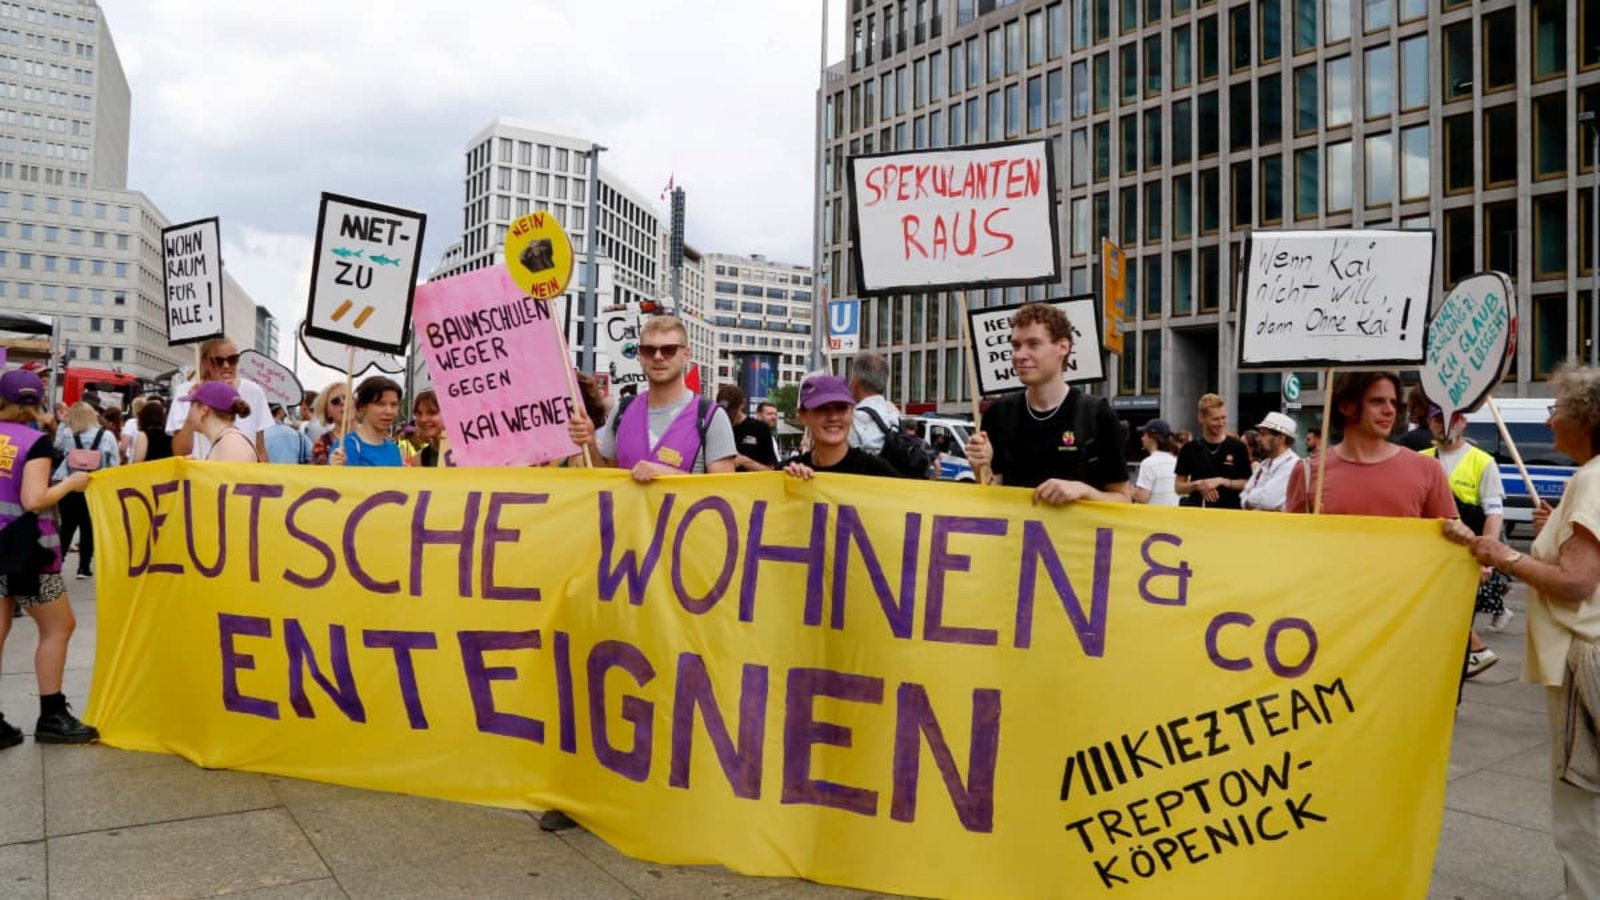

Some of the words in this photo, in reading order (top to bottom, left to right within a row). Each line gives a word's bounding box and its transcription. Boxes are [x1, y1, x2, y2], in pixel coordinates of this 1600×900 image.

[864, 157, 1041, 206] SPEKULANTEN
[166, 230, 203, 258] WOHN
[513, 212, 545, 238] NEIN
[901, 207, 1015, 261] RAUS
[168, 254, 207, 279] RAUM
[334, 260, 373, 289] ZU
[1259, 238, 1313, 275] Wenn
[1329, 237, 1376, 280] Kai
[531, 277, 560, 297] NEIN
[1256, 274, 1320, 303] nicht
[426, 296, 551, 348] BAUMSCHULEN
[831, 303, 851, 333] U
[1305, 307, 1347, 332] Ohne
[1438, 352, 1458, 387] ICH
[1459, 292, 1499, 353] GLAUB
[436, 337, 509, 371] WEGER
[1448, 368, 1471, 406] DASS
[1470, 306, 1509, 372] LOSGEHT
[448, 369, 511, 397] GEGEN
[460, 412, 500, 444] KAI
[502, 396, 575, 434] WEGNER
[117, 479, 549, 602] DEUTSCHE
[597, 490, 1114, 658] WOHNEN
[1138, 532, 1193, 606] &
[1204, 611, 1319, 679] CO
[217, 612, 1001, 834] ENTEIGNEN
[1066, 751, 1313, 854] TREPTOW-
[1093, 793, 1328, 890] KÖPENICK
